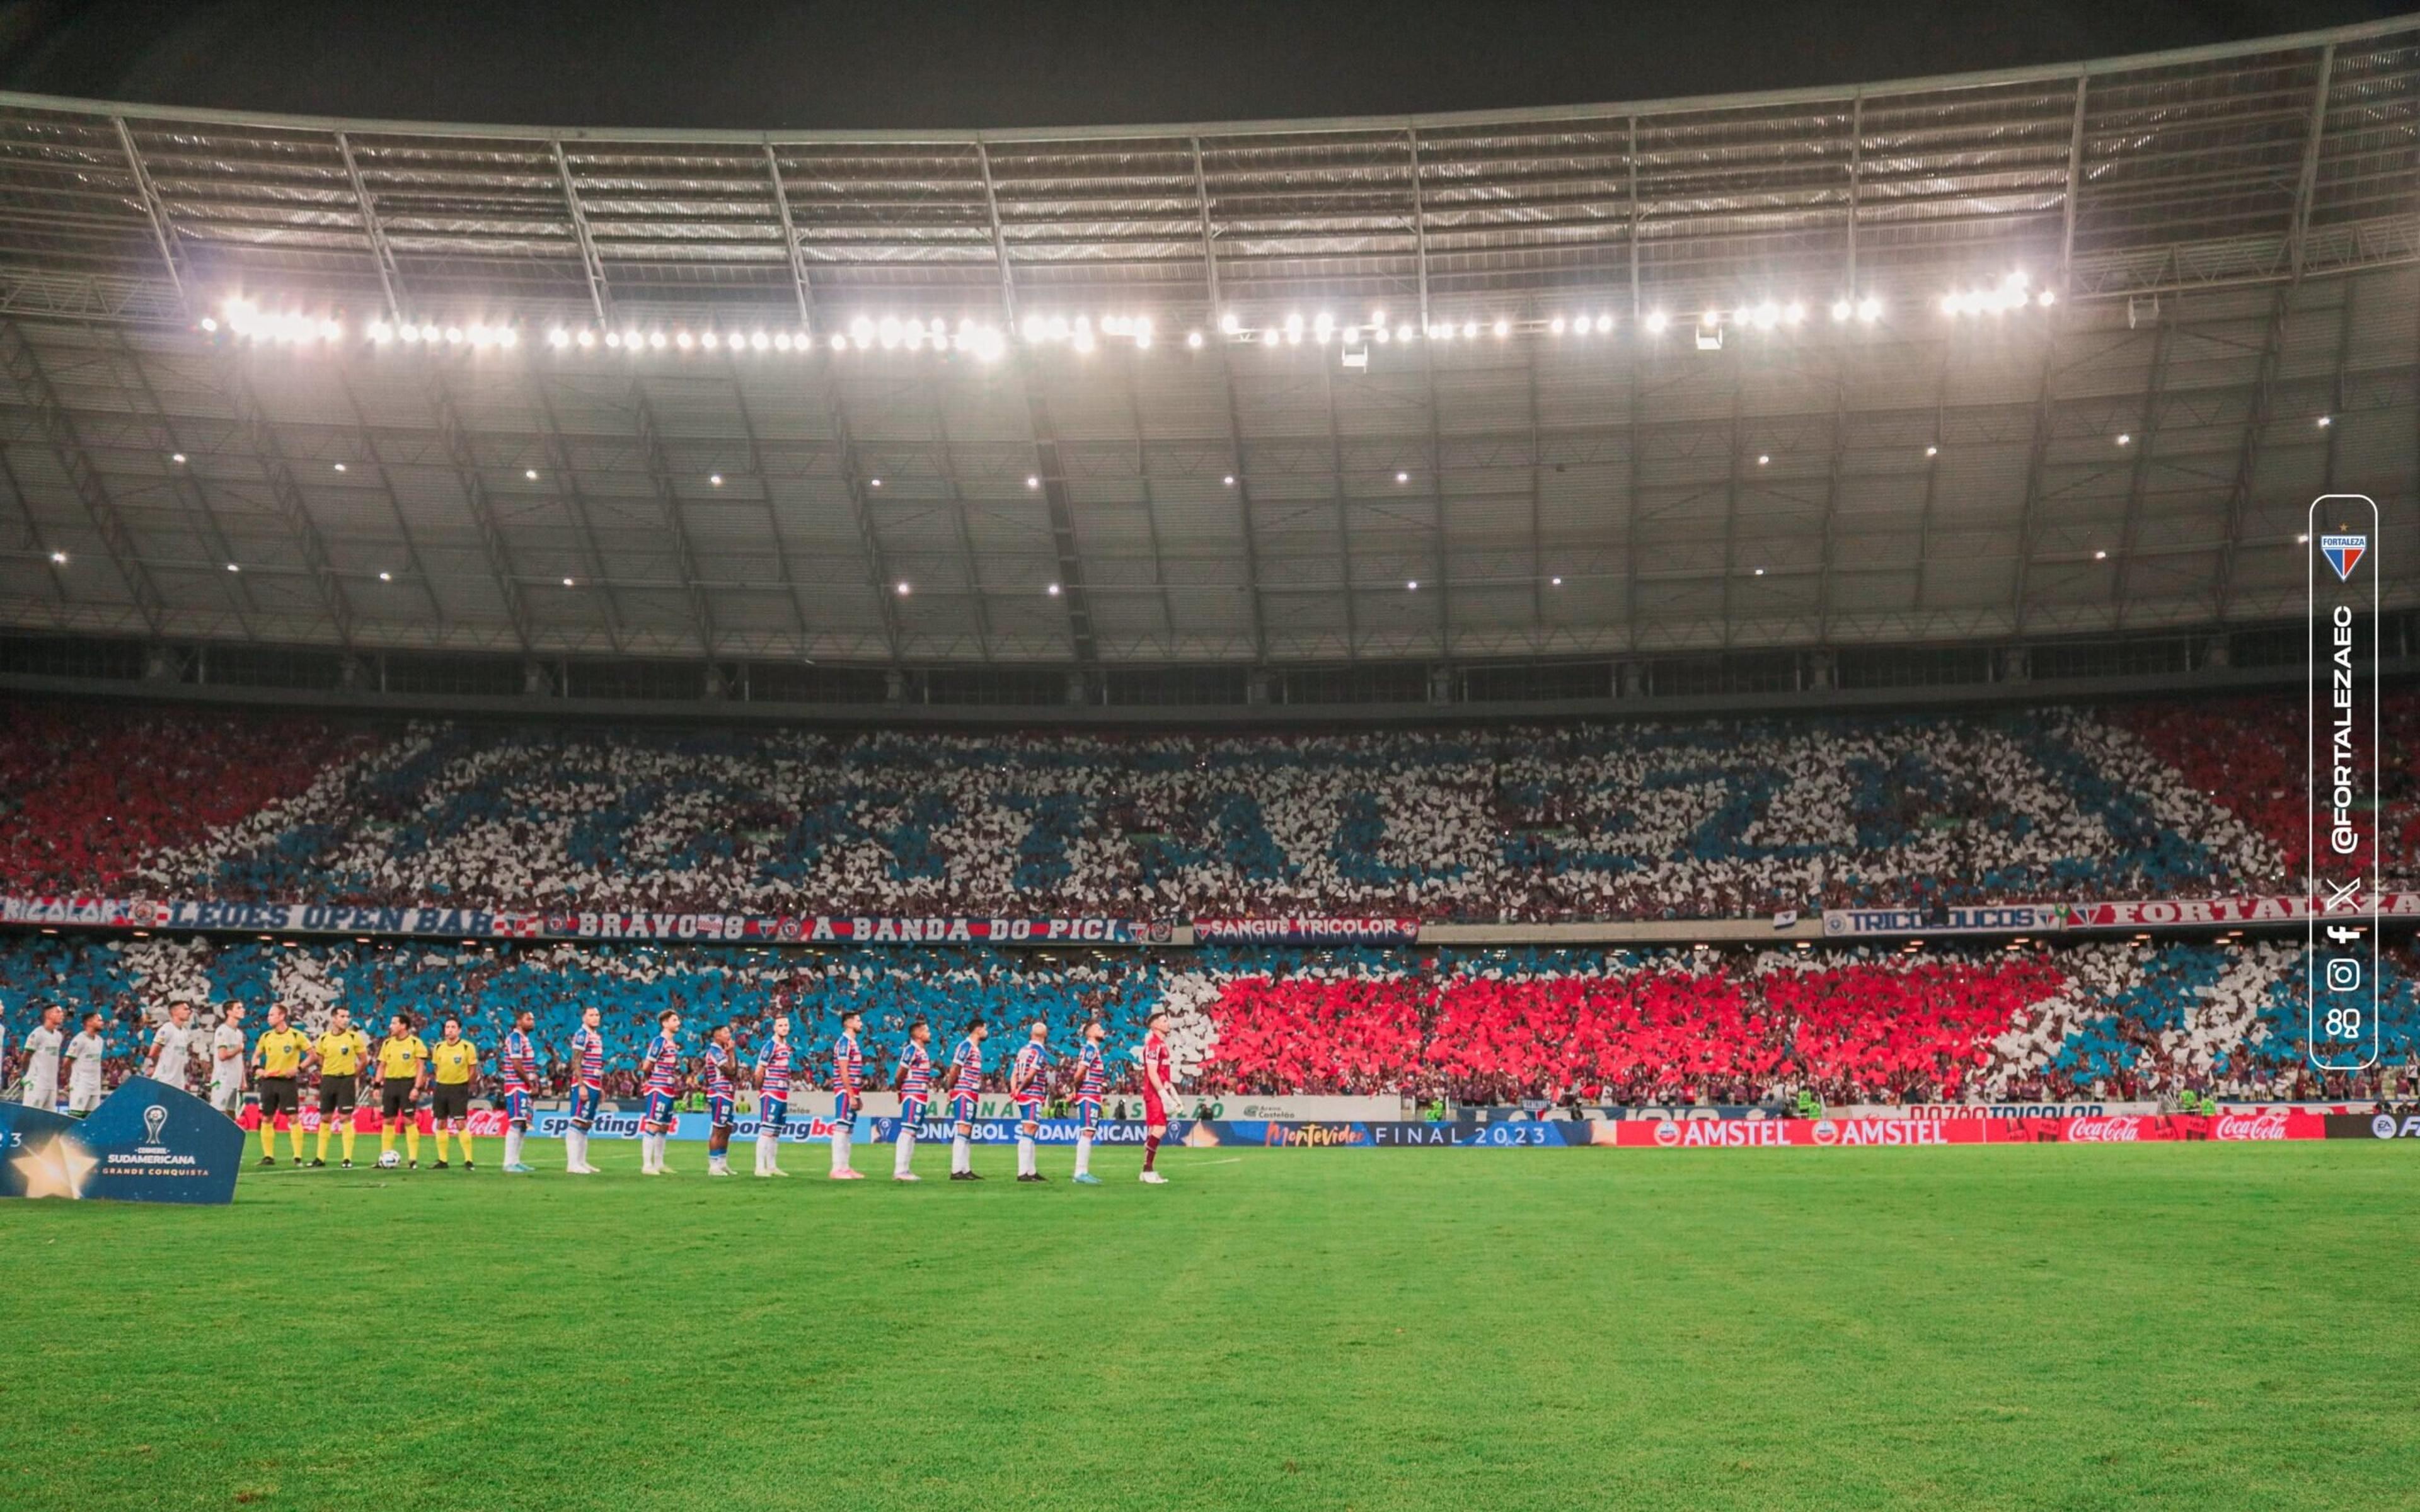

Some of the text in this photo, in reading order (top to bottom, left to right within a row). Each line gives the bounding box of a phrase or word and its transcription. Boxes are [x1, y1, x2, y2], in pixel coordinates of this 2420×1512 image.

[300, 905, 401, 932] OPEN
[413, 907, 494, 936] BAR
[577, 913, 697, 939] BRAVO
[812, 917, 835, 941] A
[852, 917, 972, 941] BANDA
[988, 919, 1031, 941] DO
[1047, 919, 1117, 941] PICI
[1211, 913, 1398, 941] SANGUE TRICOLOR
[1265, 1120, 1364, 1148] Montevideo
[1376, 1127, 1545, 1144] FINAL 2023
[1683, 1121, 1791, 1145] AMSTEL
[1840, 1120, 1948, 1144] AMSTEL
[2068, 1116, 2141, 1142] Coca-Cola
[2217, 1115, 2291, 1140] Coca-Cola
[107, 1154, 196, 1165] SUDAMERICANA
[148, 1168, 209, 1176] CONQUISTA
